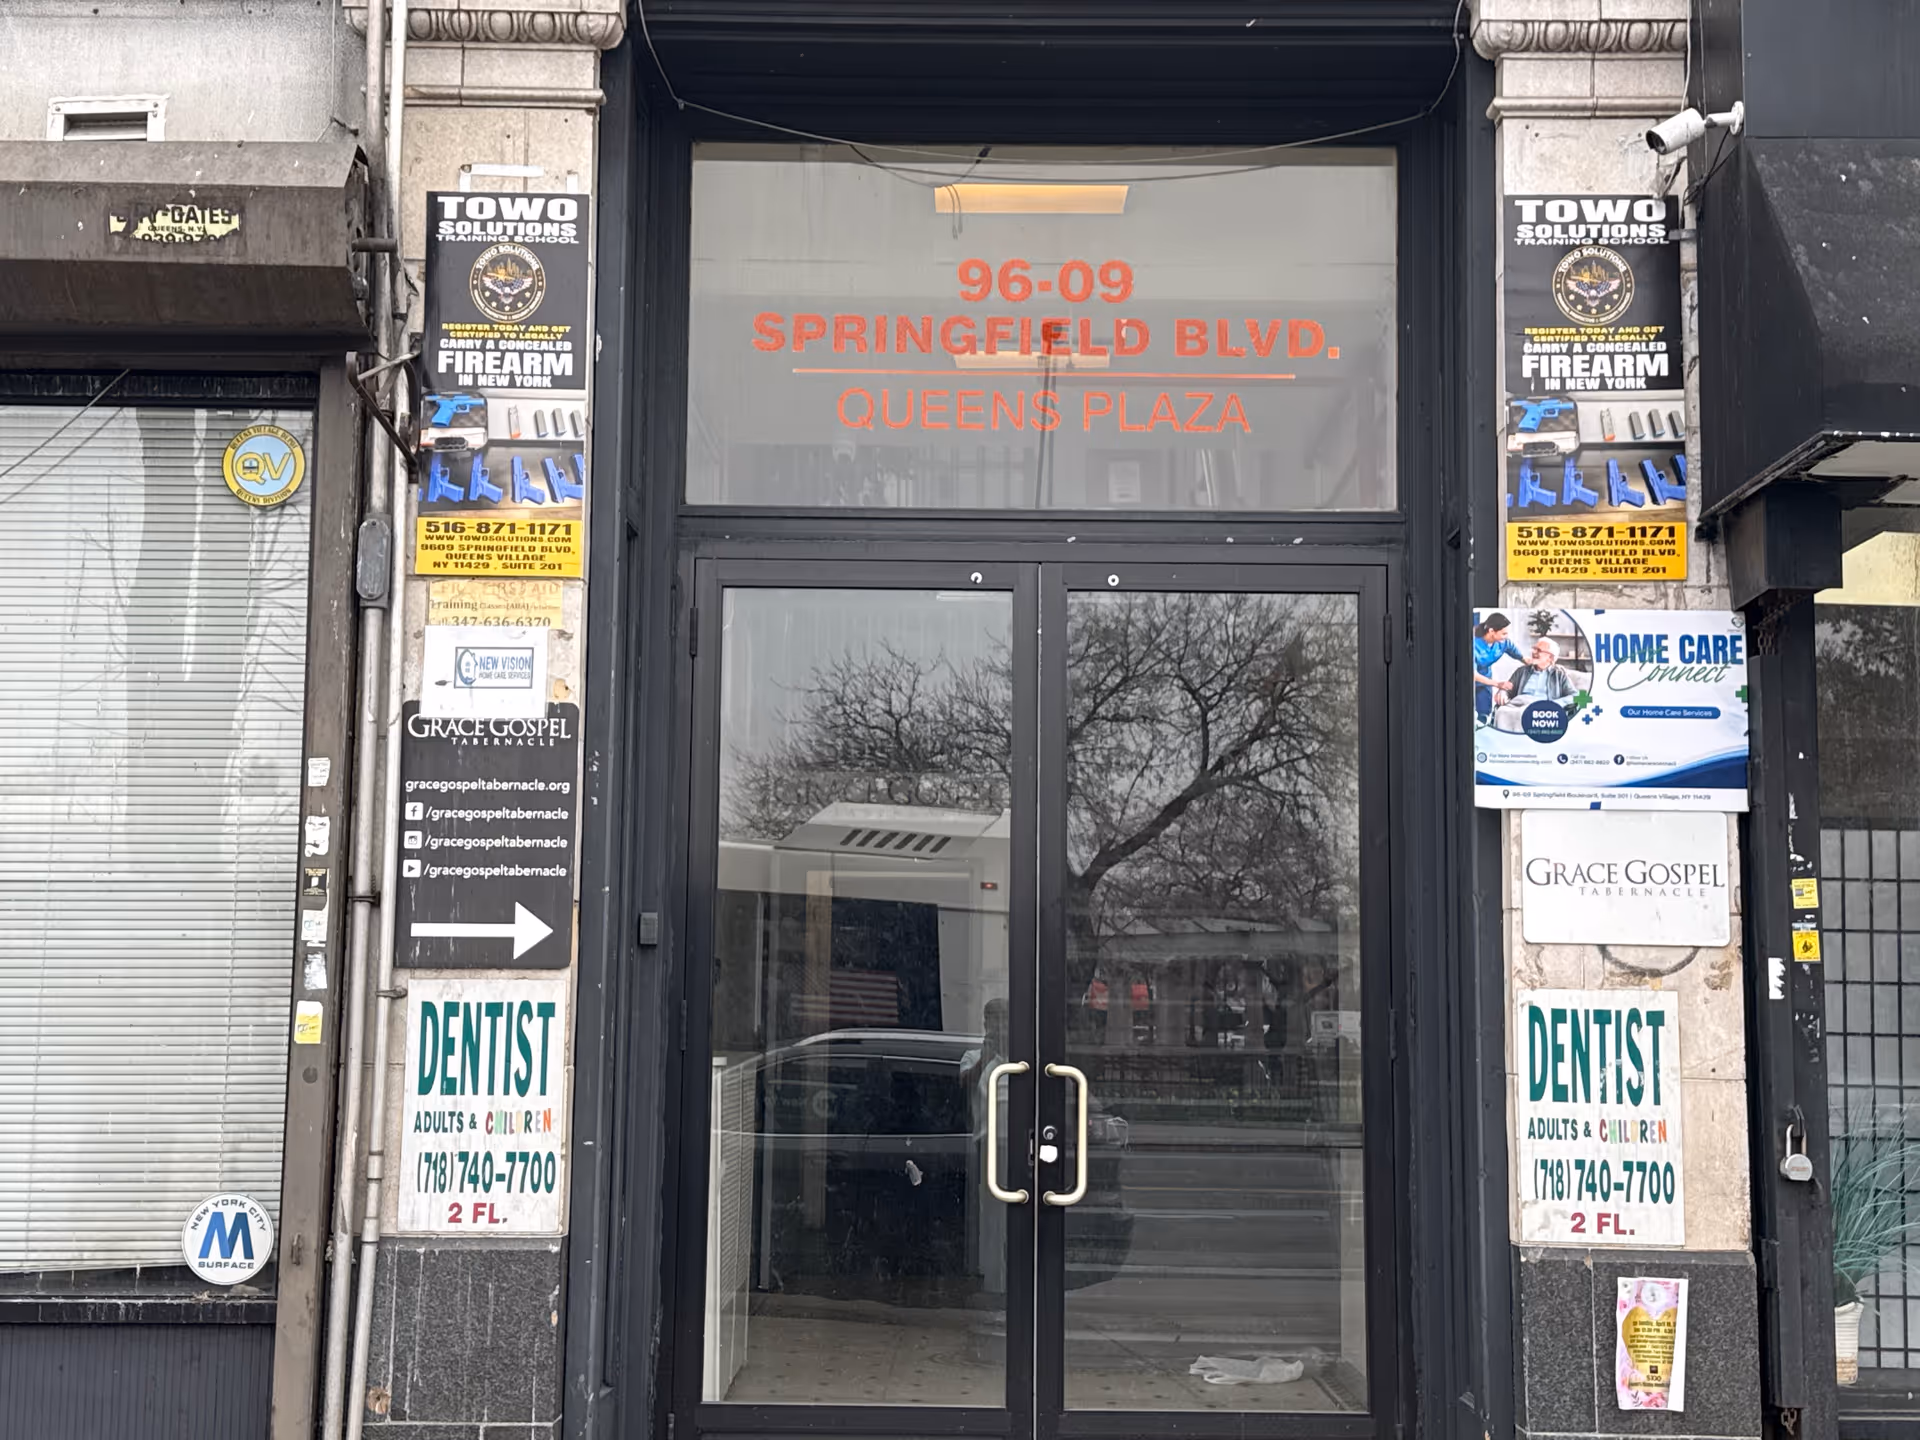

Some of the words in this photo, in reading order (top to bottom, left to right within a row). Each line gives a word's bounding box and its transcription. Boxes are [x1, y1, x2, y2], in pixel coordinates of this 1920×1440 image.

[437, 196, 578, 221] TOWO
[1514, 199, 1666, 223] TOWO
[438, 221, 577, 237] SOLUTIONS
[1517, 224, 1666, 238] SOLUTIONS
[436, 234, 509, 242] TRAINING
[514, 236, 579, 244] SCHOOL
[475, 248, 498, 269] TOWO
[1558, 250, 1581, 273] TOWO
[957, 258, 1135, 304] 96-09
[442, 323, 490, 331] REGISTER
[492, 324, 526, 332] TODAY
[551, 325, 571, 333] GET
[450, 331, 500, 339] CERTIFIED
[519, 332, 563, 340] LEGALLY
[1524, 327, 1577, 335] REGISTER
[751, 312, 1151, 359] SPRINGFIELD
[1174, 318, 1340, 360] BLVD.
[440, 338, 480, 349] CARRY
[485, 339, 495, 350] A
[498, 340, 572, 351] CONCEALED
[1523, 342, 1569, 354] CARRY
[1573, 342, 1583, 353] A
[1586, 342, 1667, 352] CONCEALED
[438, 351, 573, 376] FIREARM
[1522, 353, 1669, 378] FIREARM
[458, 374, 473, 386] IN
[477, 374, 510, 387] NEW
[514, 375, 552, 388] YORK
[1545, 378, 1561, 390] IN
[1565, 377, 1600, 390] NEW
[1604, 377, 1647, 389] YORK
[836, 388, 1062, 433] QUEENS
[1083, 392, 1252, 433] PLAZA
[235, 451, 292, 485] QV
[425, 521, 572, 536] 516-871-1171
[1517, 525, 1676, 539] 516-871-1171
[424, 534, 572, 543] WWW.TOWOSOLUTIONS.COM
[458, 544, 536, 553] SPRINGFIELD
[1553, 548, 1638, 557] SPRINGFIELD
[445, 553, 492, 561] QUEENS
[1539, 557, 1591, 565] QUEENS
[1595, 557, 1649, 565] VILLAGE
[501, 562, 535, 570] SUITE
[1549, 566, 1589, 574] 11429
[1600, 566, 1638, 574] SUITE
[1642, 566, 1667, 574] 201
[1594, 633, 1669, 665] HOME
[1678, 634, 1744, 665] CARE
[480, 656, 499, 670] NEW
[501, 656, 532, 671] VISION
[1607, 646, 1733, 692] Connect
[1532, 710, 1559, 719] BOOK
[1683, 709, 1713, 717] Services
[407, 713, 485, 738] GRACE
[489, 718, 572, 739] GOSPEL
[1531, 719, 1559, 728] NOW!
[451, 737, 555, 746] TABERNACLE
[405, 778, 571, 794] gracegospeltabernacle.org
[1526, 857, 1618, 886] GRACE
[1624, 860, 1725, 888] GOSPEL
[1578, 886, 1706, 897] TABERNACLE
[417, 1000, 556, 1097] DENTIST
[1528, 1005, 1665, 1107] DENTIST
[413, 1111, 464, 1133] ADULTS
[469, 1112, 477, 1130] &
[485, 1108, 552, 1135] CHILDREN
[1528, 1117, 1578, 1141] ADULTS
[1584, 1121, 1592, 1139] &
[1599, 1119, 1667, 1144] CHILDREN
[190, 1206, 209, 1231] NEW
[212, 1199, 247, 1209] YORK
[248, 1206, 266, 1231] CITY
[448, 1203, 463, 1223] 2
[472, 1203, 508, 1224] FL.
[1570, 1212, 1586, 1234] 2
[1597, 1212, 1635, 1235] FL.
[198, 1261, 254, 1269] SURFACE
